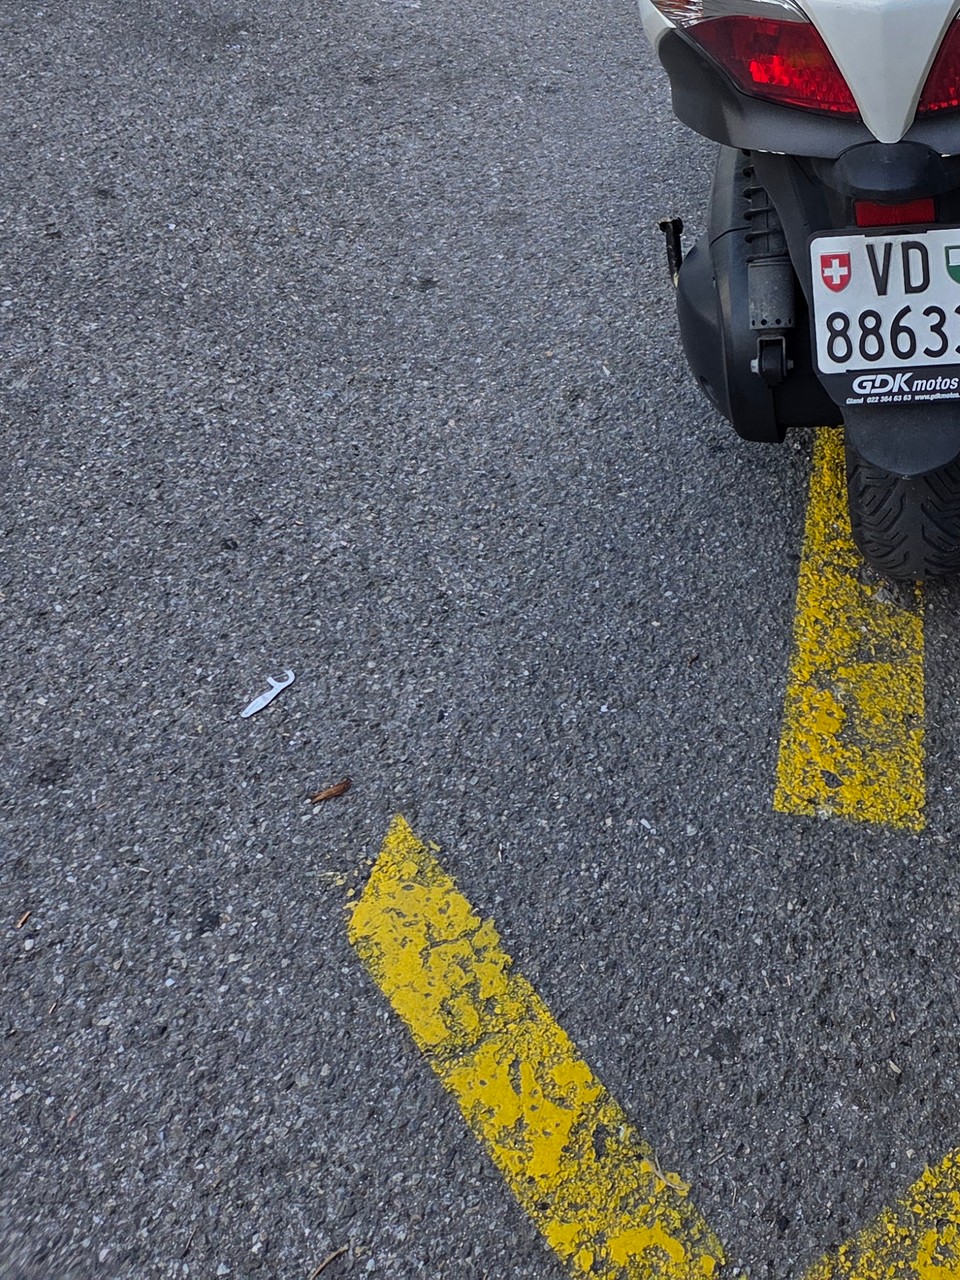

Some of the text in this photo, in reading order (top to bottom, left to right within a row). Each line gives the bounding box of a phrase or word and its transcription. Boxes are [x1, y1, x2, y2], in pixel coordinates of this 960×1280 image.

[866, 240, 930, 296] VD
[852, 372, 959, 394] GDK motos
[846, 397, 864, 405] Gland
